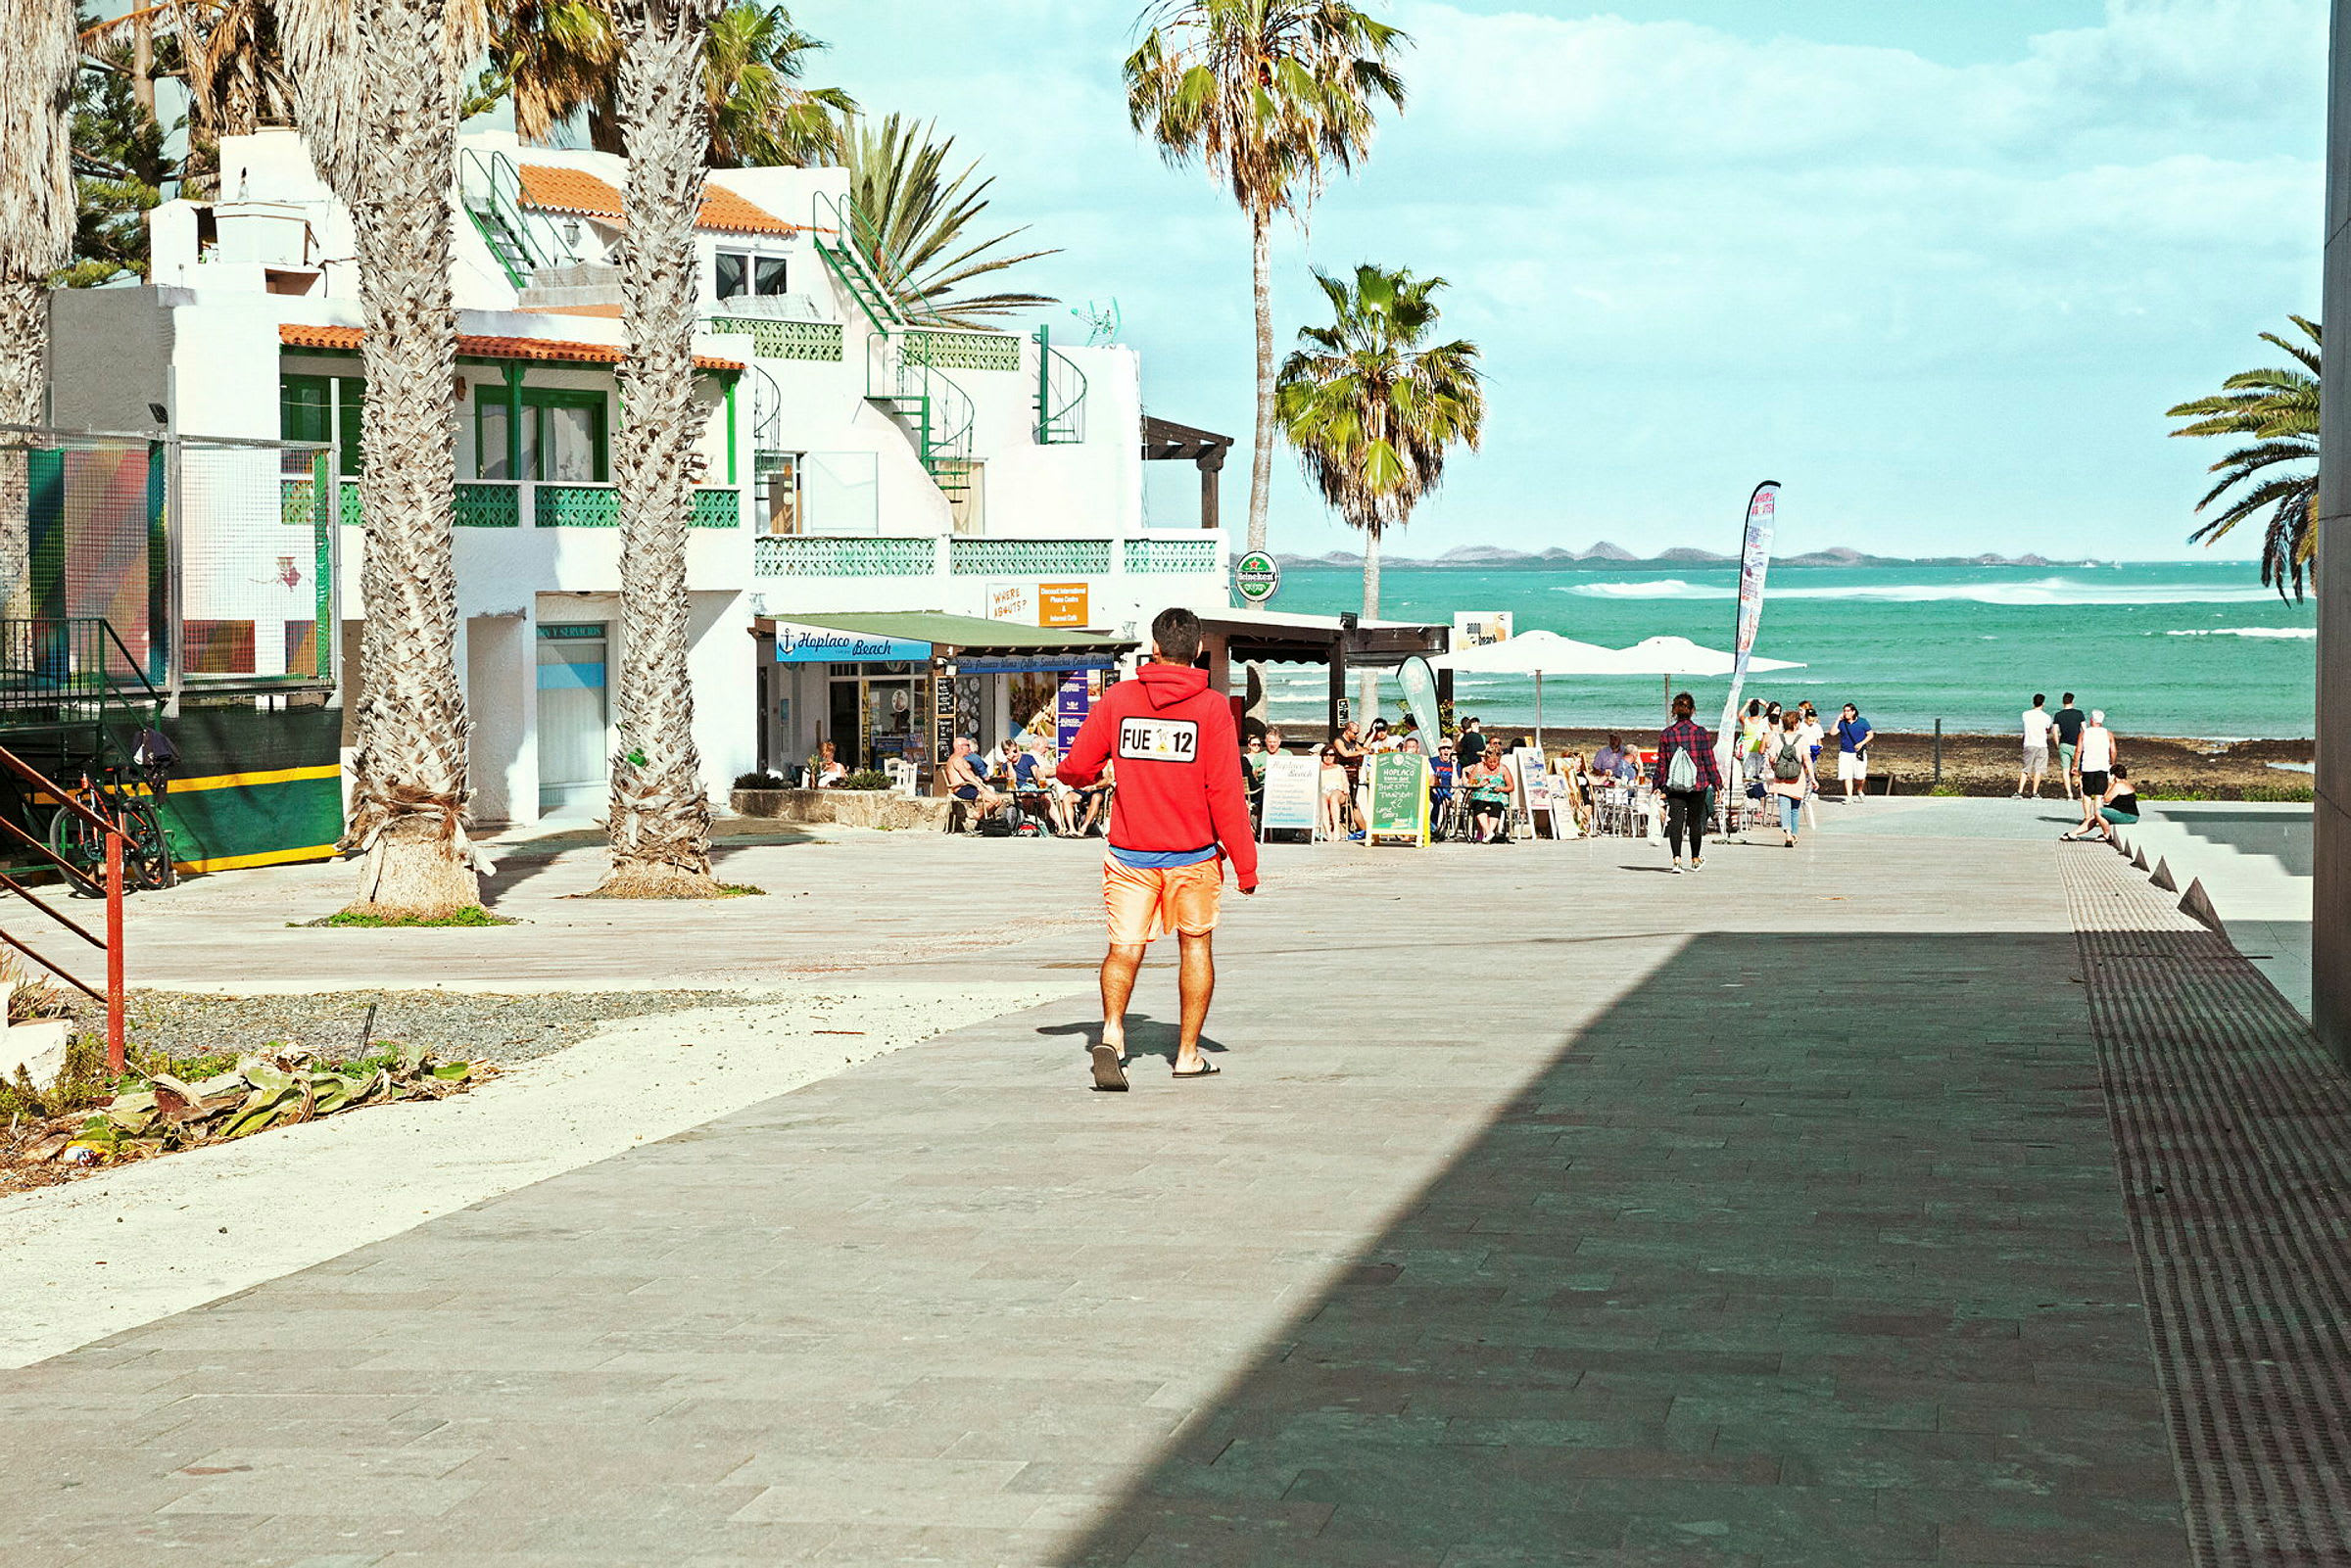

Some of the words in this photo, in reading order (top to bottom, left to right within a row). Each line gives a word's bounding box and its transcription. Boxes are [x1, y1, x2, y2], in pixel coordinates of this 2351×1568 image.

[993, 588, 1020, 604] WHERE
[993, 599, 1028, 618] ABOUTS?
[798, 632, 850, 652] Hoplaco
[852, 640, 891, 656] Beach
[1122, 729, 1152, 750] FUE
[1173, 732, 1193, 752] 12
